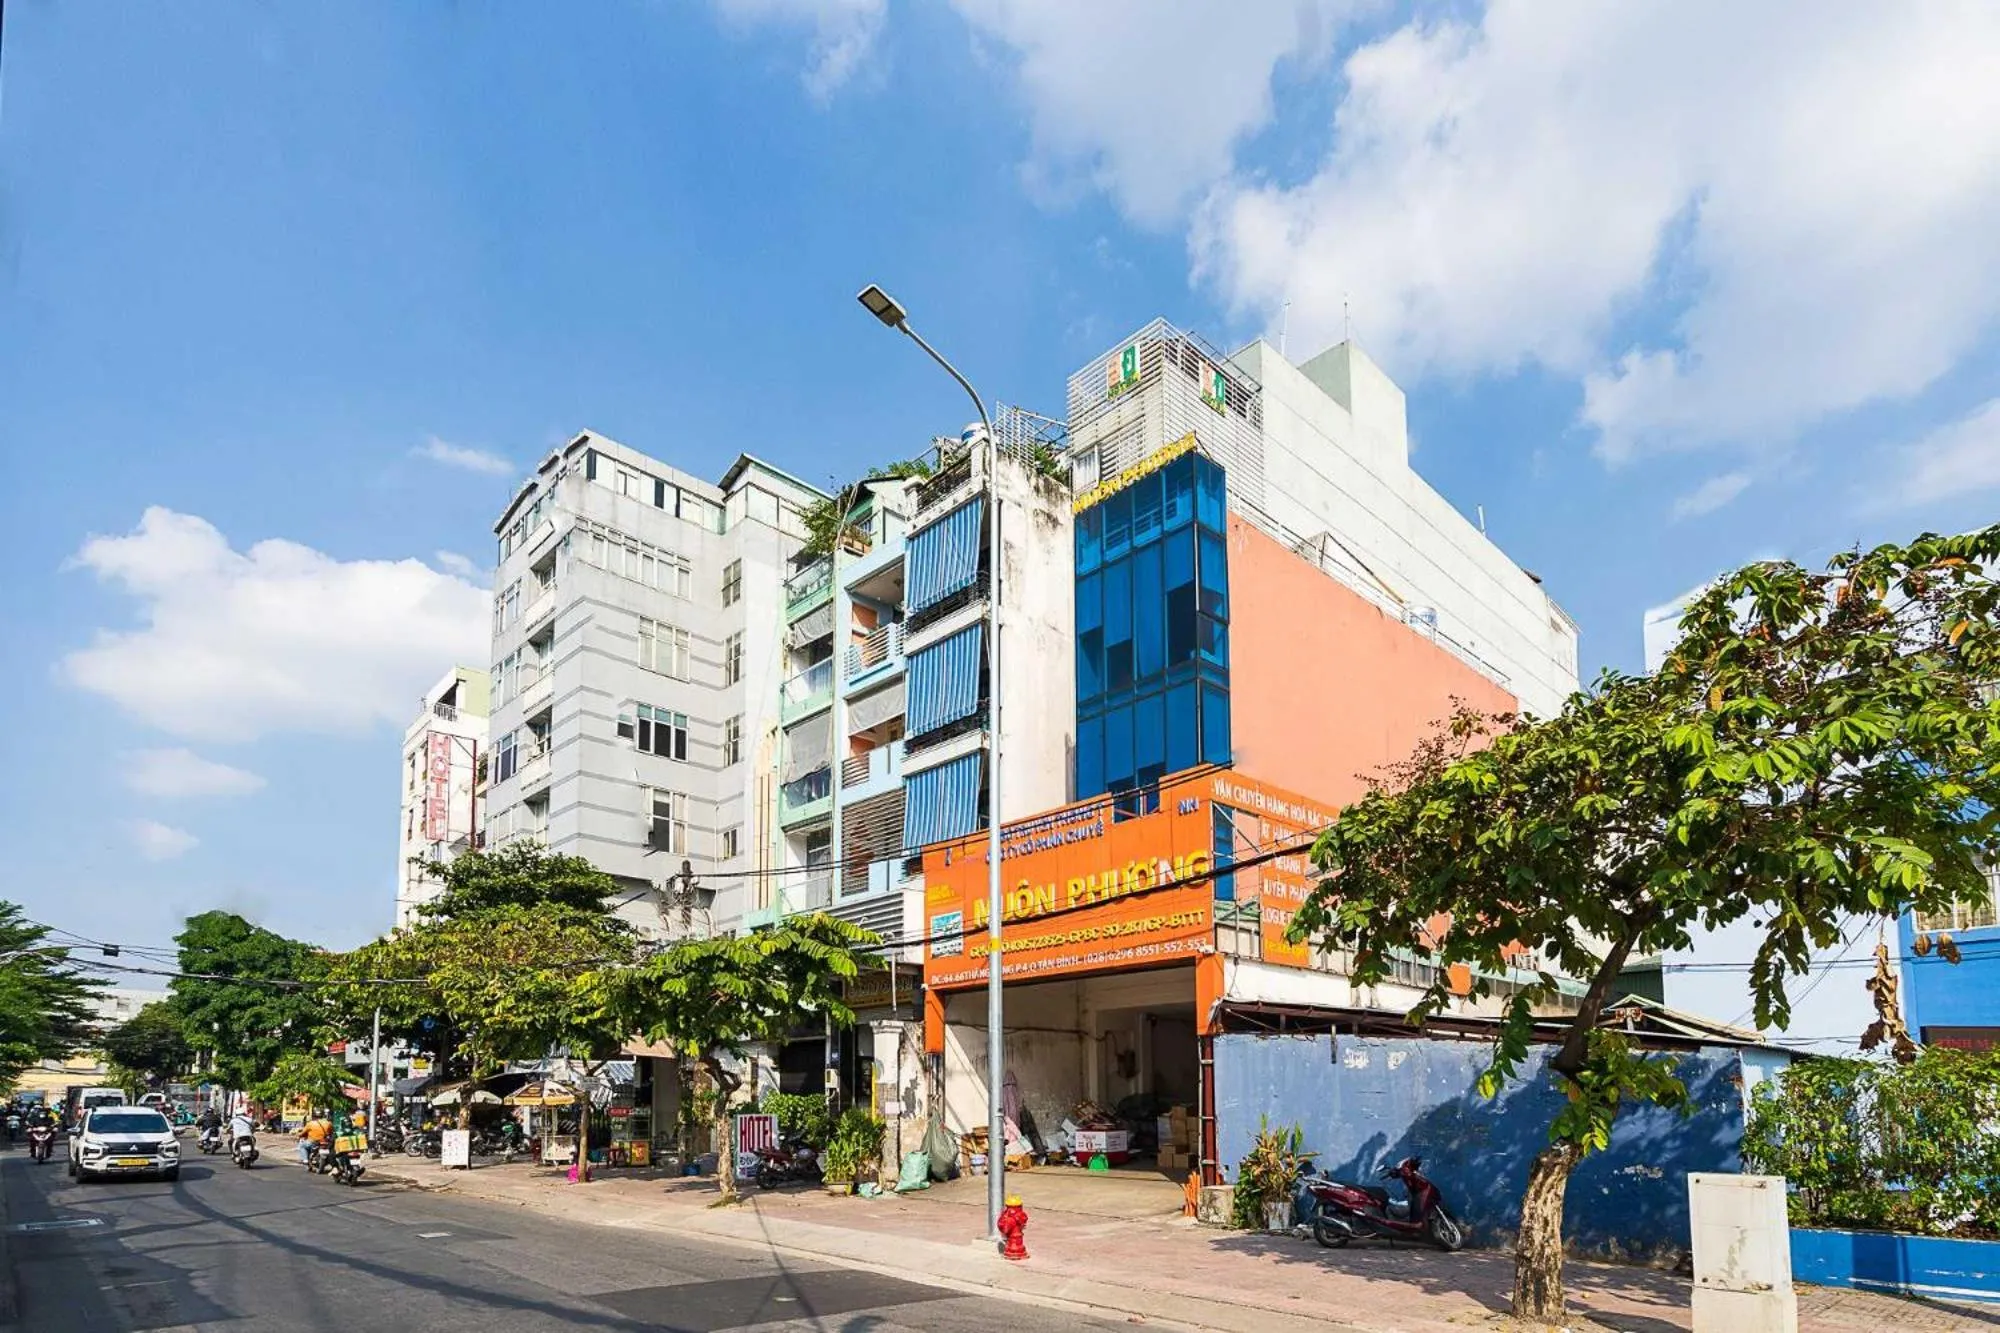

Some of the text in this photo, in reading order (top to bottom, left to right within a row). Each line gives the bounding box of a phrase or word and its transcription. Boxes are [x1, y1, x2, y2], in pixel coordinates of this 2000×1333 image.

[429, 733, 450, 840] HOTEL
[1067, 849, 1211, 909] PHƯƠNG
[739, 1115, 775, 1153] HOTEL
